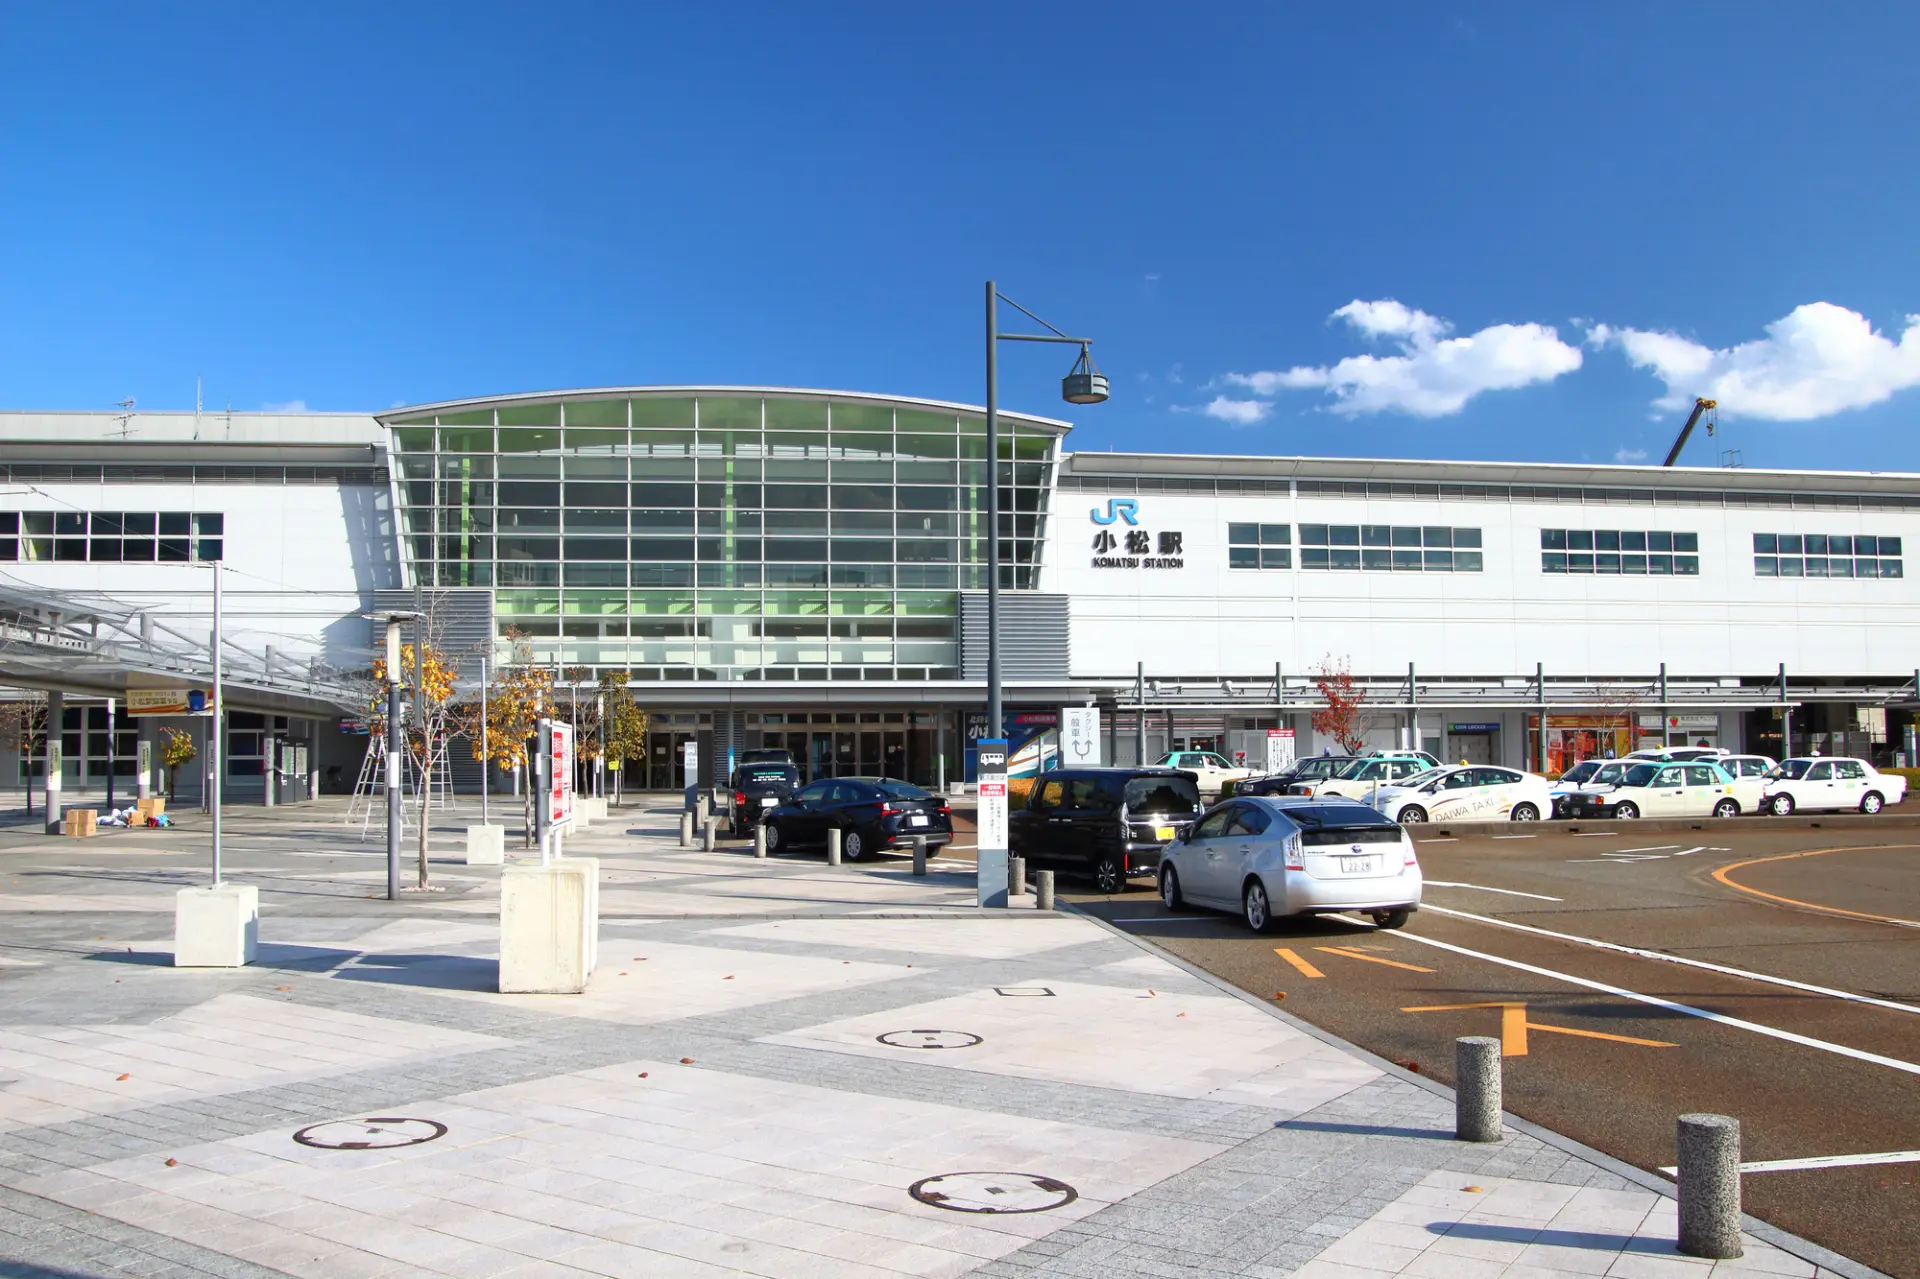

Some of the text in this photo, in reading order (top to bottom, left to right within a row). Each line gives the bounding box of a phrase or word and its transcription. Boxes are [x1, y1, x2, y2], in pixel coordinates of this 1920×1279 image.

[1090, 498, 1140, 526] JR
[1091, 529, 1184, 555] 小松駅
[1092, 557, 1184, 569] KOMATSU STATION
[1070, 711, 1080, 737] 一般車
[1435, 796, 1495, 822] DAIWA TAXI
